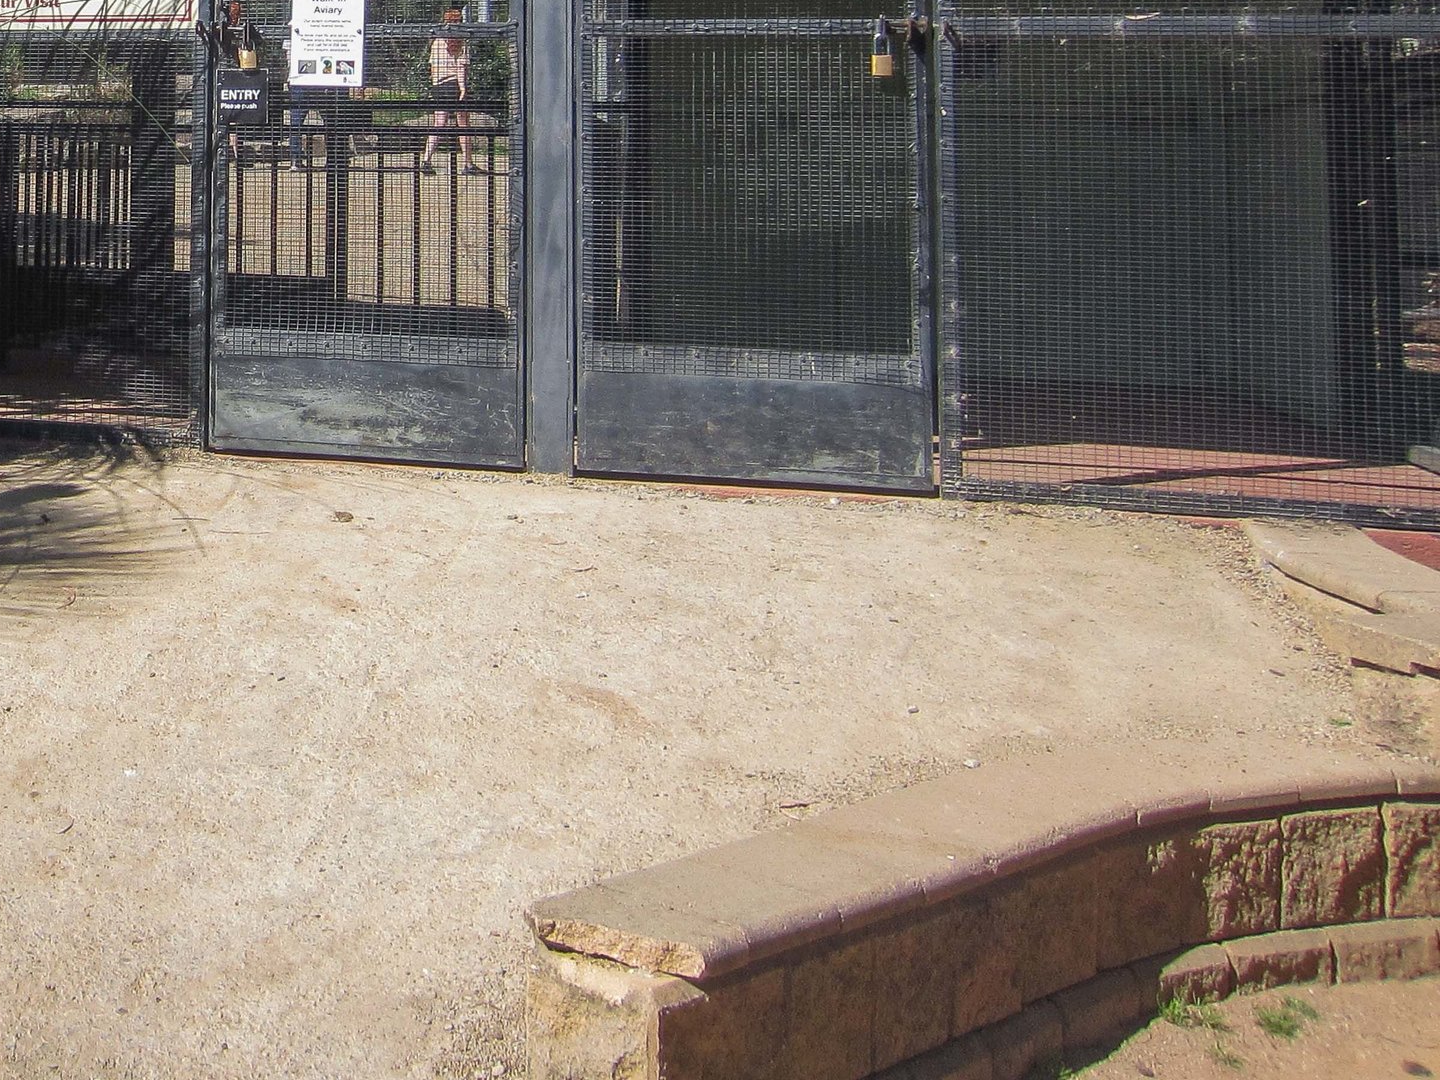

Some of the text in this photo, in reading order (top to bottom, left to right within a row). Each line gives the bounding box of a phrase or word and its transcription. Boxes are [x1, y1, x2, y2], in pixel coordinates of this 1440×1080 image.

[313, 5, 343, 15] Aviary
[220, 89, 260, 101] ENTRY
[220, 102, 258, 110] Please push
